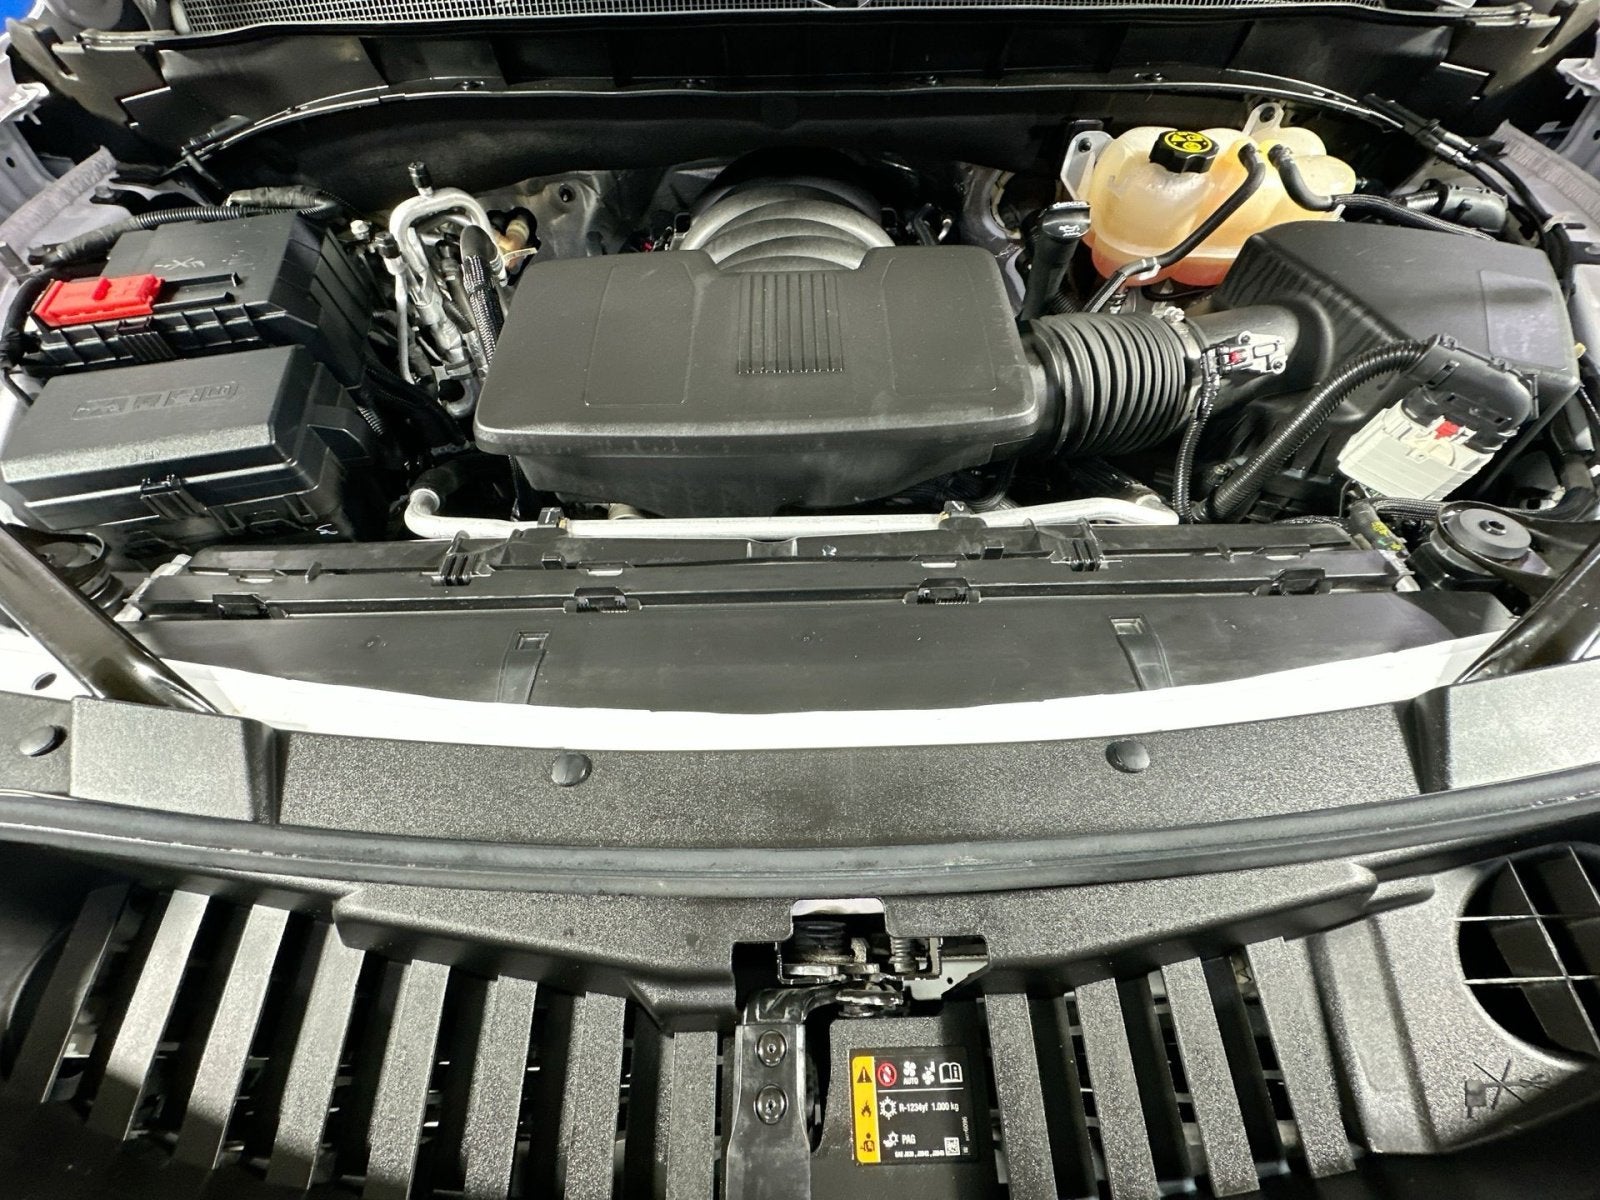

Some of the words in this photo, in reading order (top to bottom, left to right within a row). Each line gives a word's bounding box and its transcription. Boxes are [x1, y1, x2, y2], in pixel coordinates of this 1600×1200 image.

[903, 1077, 919, 1085] AUTO
[931, 1102, 950, 1111] 1.000
[951, 1101, 960, 1112] kg
[901, 1134, 917, 1145] PAG
